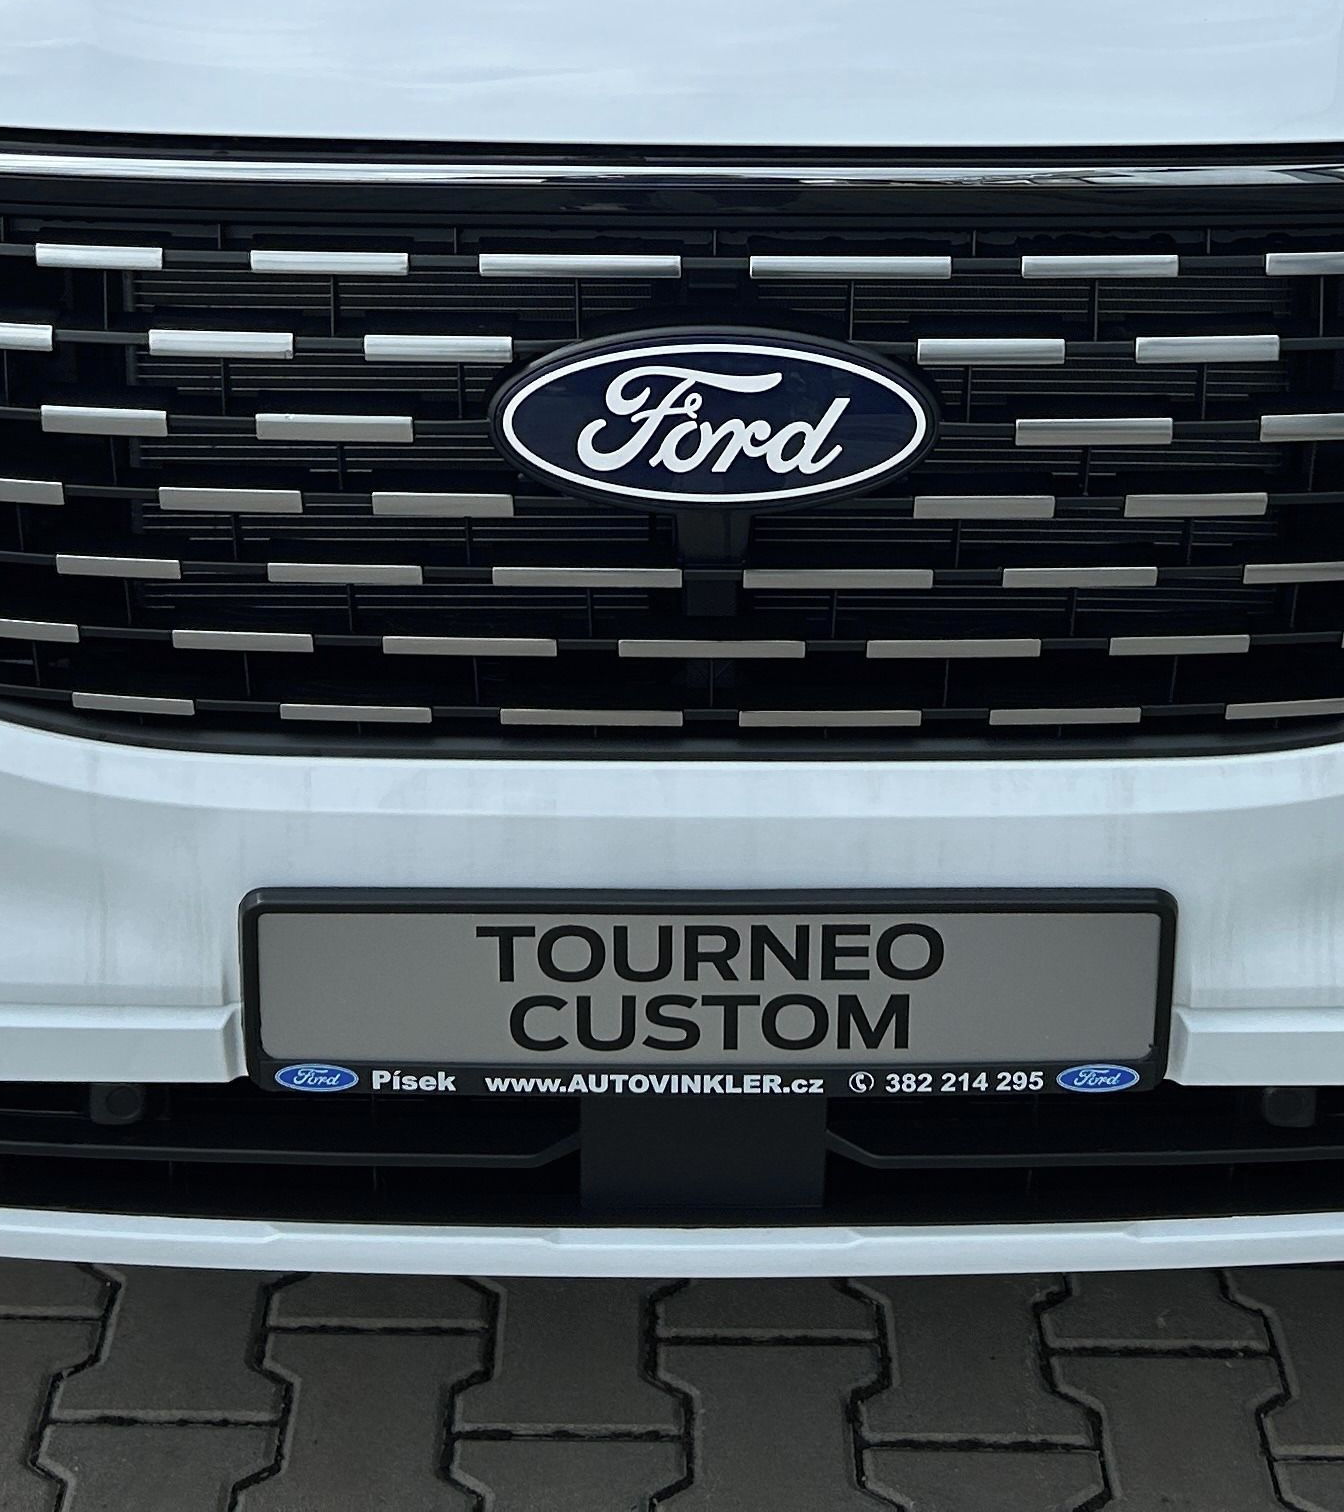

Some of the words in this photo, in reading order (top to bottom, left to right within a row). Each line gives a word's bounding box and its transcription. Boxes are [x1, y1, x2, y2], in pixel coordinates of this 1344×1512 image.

[576, 365, 851, 475] Ford
[475, 923, 945, 983] TOURNEO
[509, 994, 910, 1052] CUSTOM
[293, 1067, 340, 1086] Ford
[371, 1069, 457, 1092] Písek
[484, 1073, 824, 1094] www.AUTOVINKLER.cz
[885, 1072, 933, 1093] 382
[940, 1071, 989, 1092] 214
[995, 1070, 1045, 1091] 295
[1073, 1068, 1120, 1087] Ford
